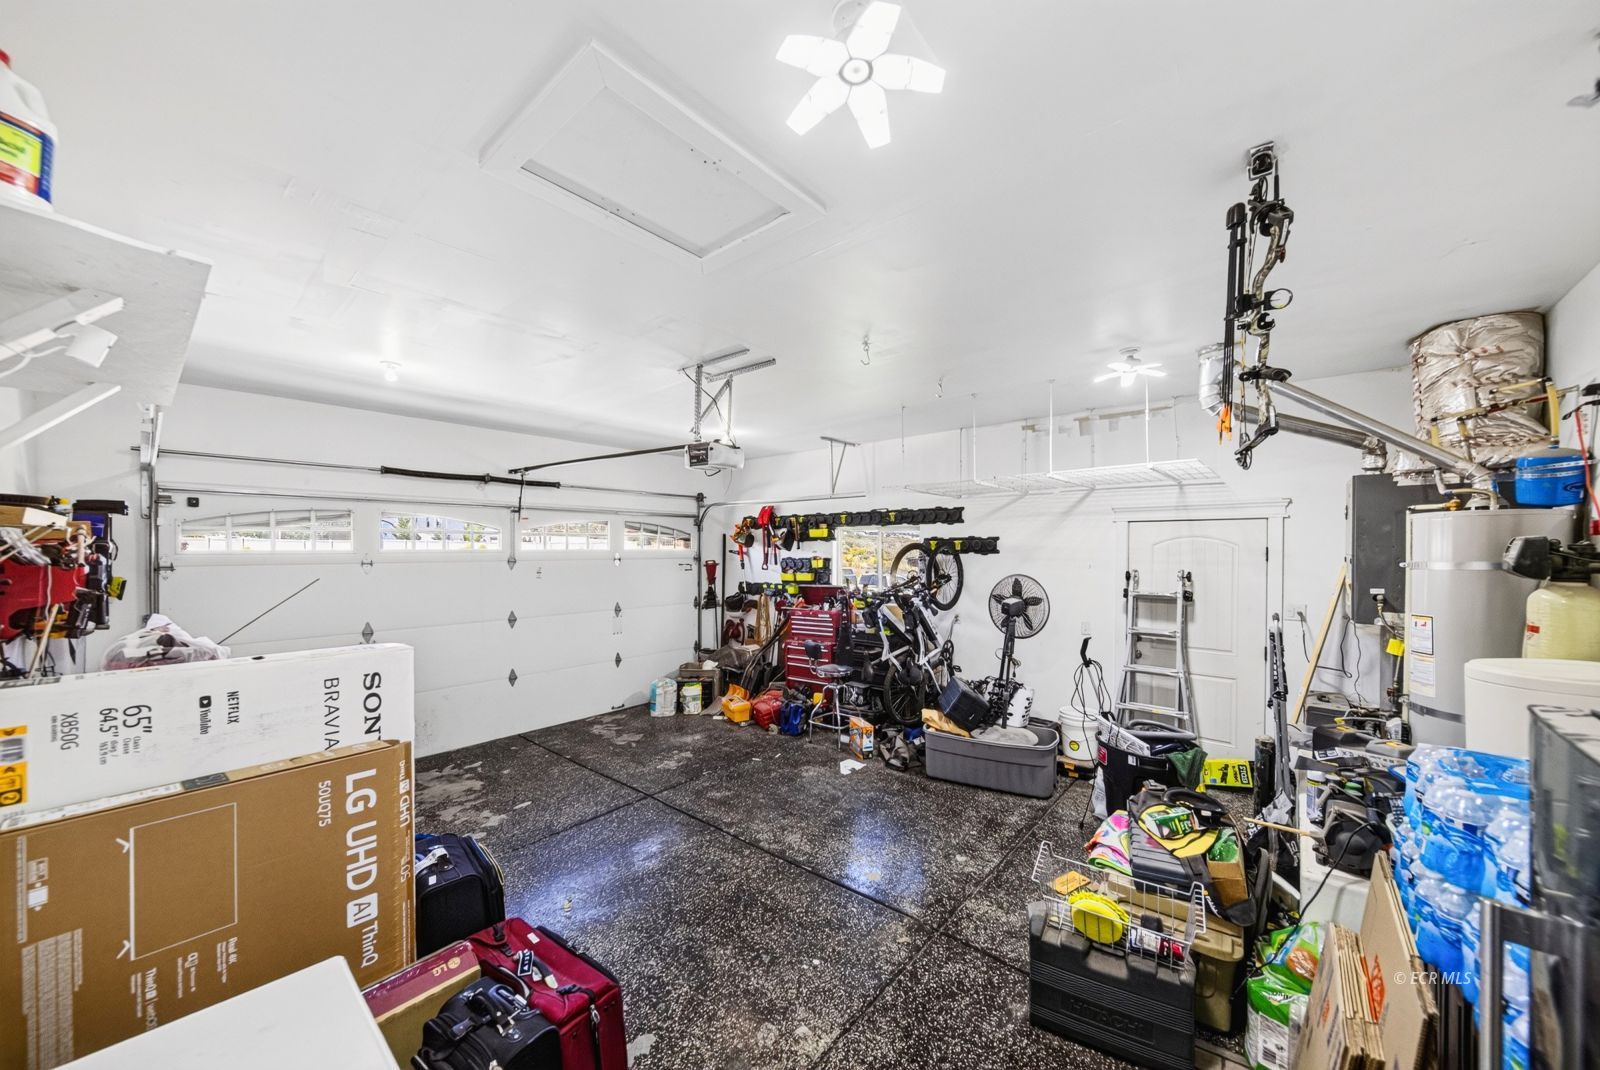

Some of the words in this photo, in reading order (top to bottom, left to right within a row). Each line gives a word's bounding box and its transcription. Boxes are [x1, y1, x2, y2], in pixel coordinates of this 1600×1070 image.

[99, 707, 119, 737] 64.5"
[122, 704, 152, 733] 65"
[199, 708, 211, 735] YouTube
[226, 690, 240, 725] NETFLIX
[324, 677, 340, 751] BRAVIA
[363, 672, 382, 740] SON
[60, 712, 79, 750] X850G
[317, 780, 331, 827] 50UQ75
[346, 768, 378, 815] LG
[399, 795, 411, 827] UHD
[346, 820, 378, 890] UHD
[361, 920, 378, 968] ThinQ
[432, 963, 448, 976] LG
